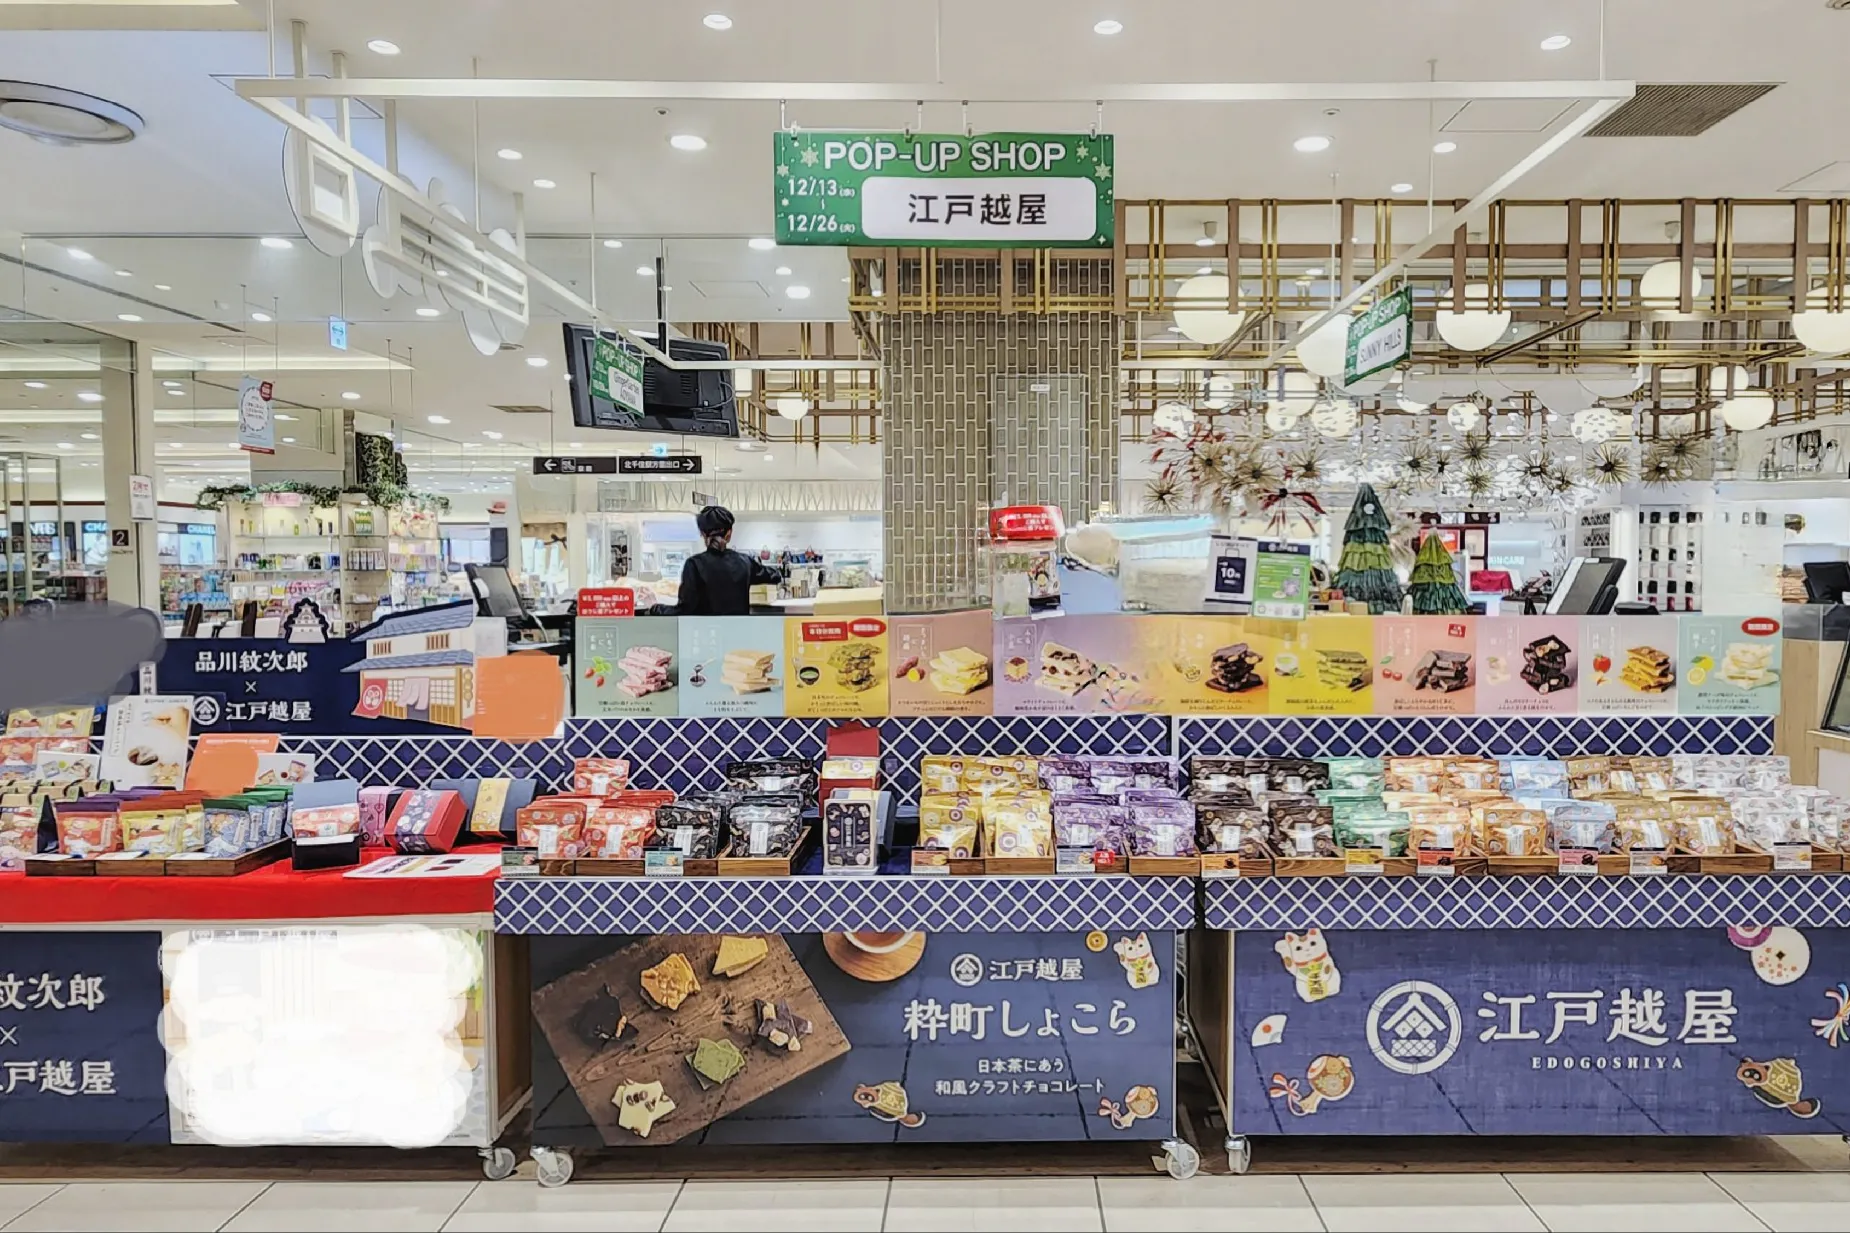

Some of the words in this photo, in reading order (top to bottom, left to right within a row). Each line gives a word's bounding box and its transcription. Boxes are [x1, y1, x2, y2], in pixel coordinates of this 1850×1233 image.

[823, 141, 962, 172] POP-UP
[970, 141, 1067, 172] SHOP
[908, 194, 1048, 225] 江戸越屋
[115, 531, 125, 546] 2
[195, 650, 308, 673] 品川紋次郎
[225, 700, 312, 722] 江戸越屋
[989, 958, 1084, 982] 江戸越屋
[902, 999, 1137, 1041] 粋町しょこら
[1477, 986, 1739, 1046] 江戸越屋
[977, 1058, 1065, 1074] 日本茶にあう
[1531, 1056, 1684, 1070] EDOGOSHIYA
[0, 1060, 117, 1096] 戸越屋
[935, 1078, 1104, 1096] 和風クラフトチョコレート
